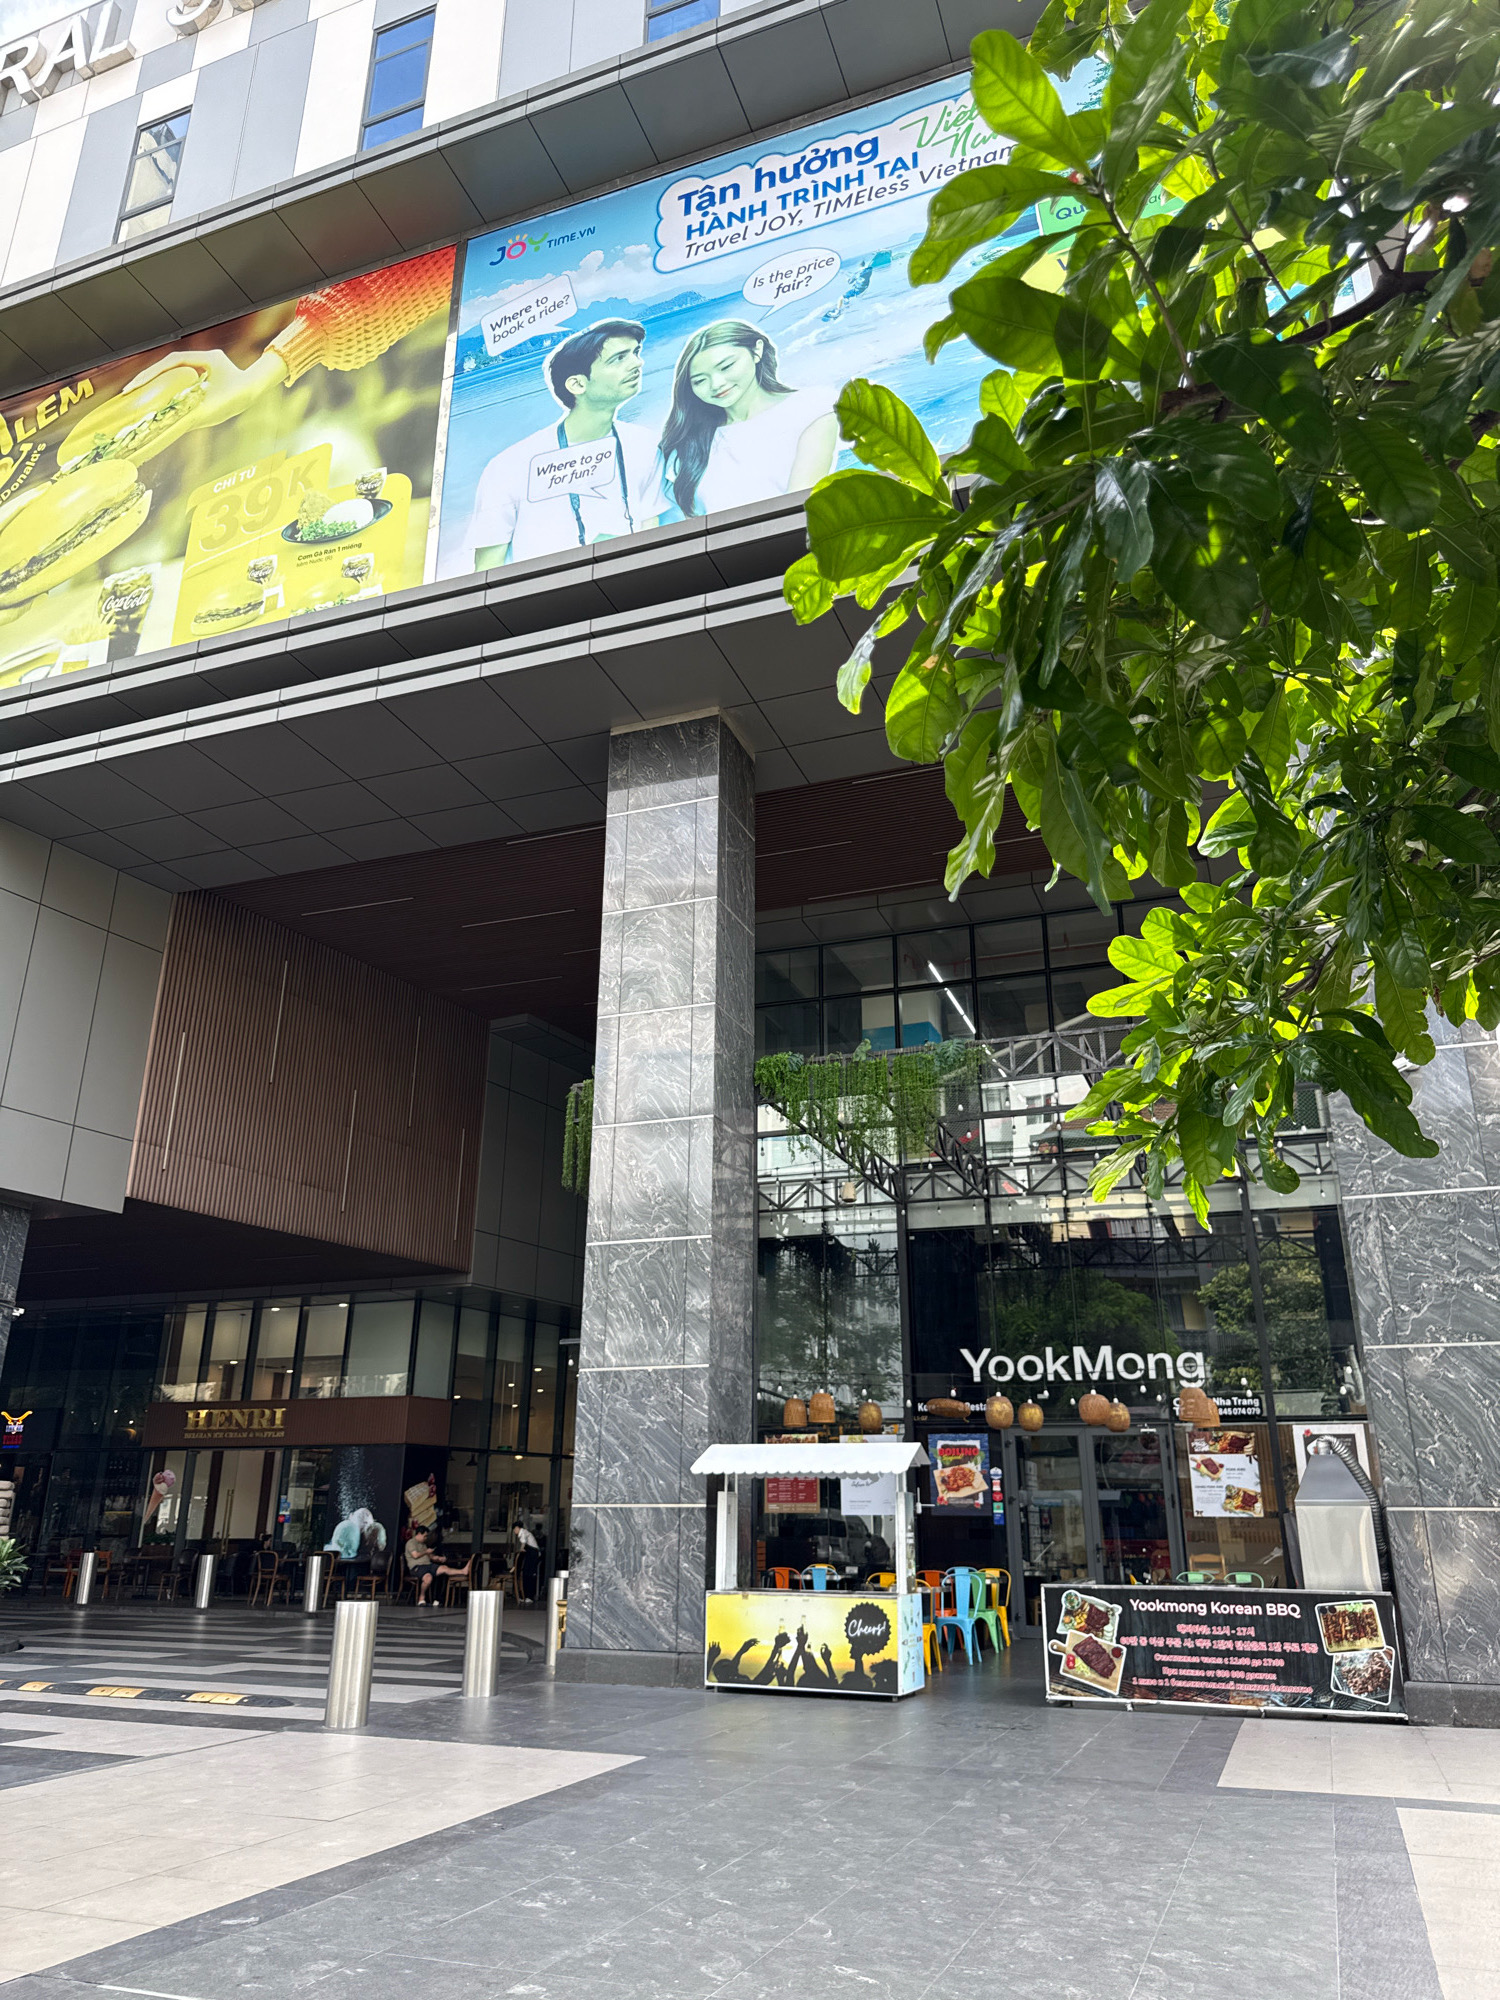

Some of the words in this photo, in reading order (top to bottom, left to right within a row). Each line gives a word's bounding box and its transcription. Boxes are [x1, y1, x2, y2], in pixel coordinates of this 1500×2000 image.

[677, 182, 741, 218] Tận
[754, 136, 880, 193] hưởng
[686, 200, 768, 241] HÀNH
[776, 169, 865, 211] TRÌNH
[873, 151, 919, 180] TẠI
[685, 226, 749, 259] Travel
[754, 209, 803, 237] JOY,
[813, 179, 910, 219] TIMEless
[753, 276, 765, 289] Is
[769, 269, 793, 284] the
[796, 257, 835, 278] price
[774, 275, 813, 299] fair?
[490, 305, 532, 332] Where
[535, 296, 549, 308] to
[492, 321, 525, 344] book
[527, 315, 536, 325] a
[539, 294, 570, 319] ride?
[536, 459, 577, 477] Where
[580, 455, 592, 466] to
[595, 450, 612, 464] go
[548, 474, 568, 489] for
[568, 464, 598, 484] fun?
[960, 1345, 1206, 1388] YookMong
[1212, 1397, 1231, 1406] Nha
[1231, 1396, 1260, 1407] Trang
[1233, 1407, 1246, 1415] 074
[1246, 1407, 1261, 1415] 079
[183, 1408, 286, 1430] HENRI
[1129, 1598, 1207, 1616] Yookmong
[1210, 1601, 1263, 1615] Korean
[1266, 1603, 1301, 1618] BBQ
[848, 1618, 887, 1637] Cheers!
